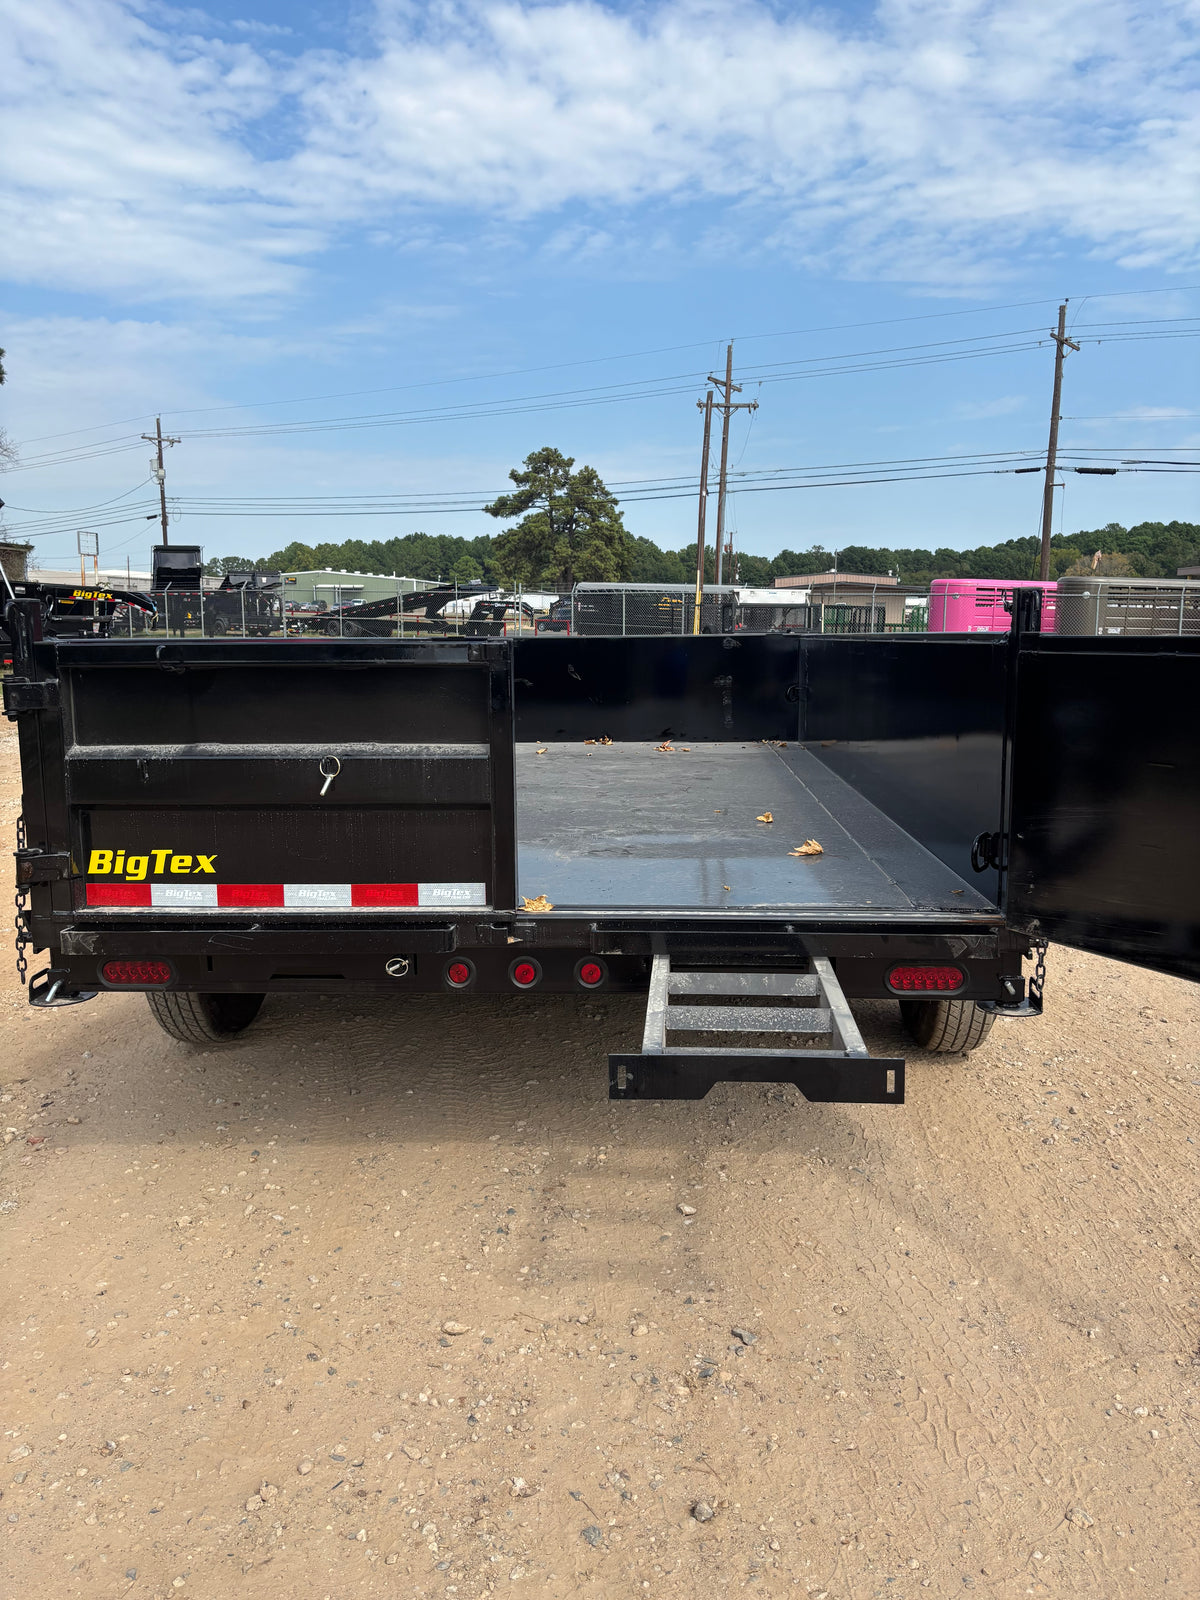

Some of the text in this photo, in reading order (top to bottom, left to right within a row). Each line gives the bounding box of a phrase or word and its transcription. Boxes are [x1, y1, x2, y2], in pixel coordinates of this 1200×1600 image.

[73, 590, 113, 600] BigTex
[88, 849, 218, 881] BigTex
[165, 889, 202, 898] BigTex
[298, 889, 336, 898] BigTex
[432, 889, 471, 898] BigTex
